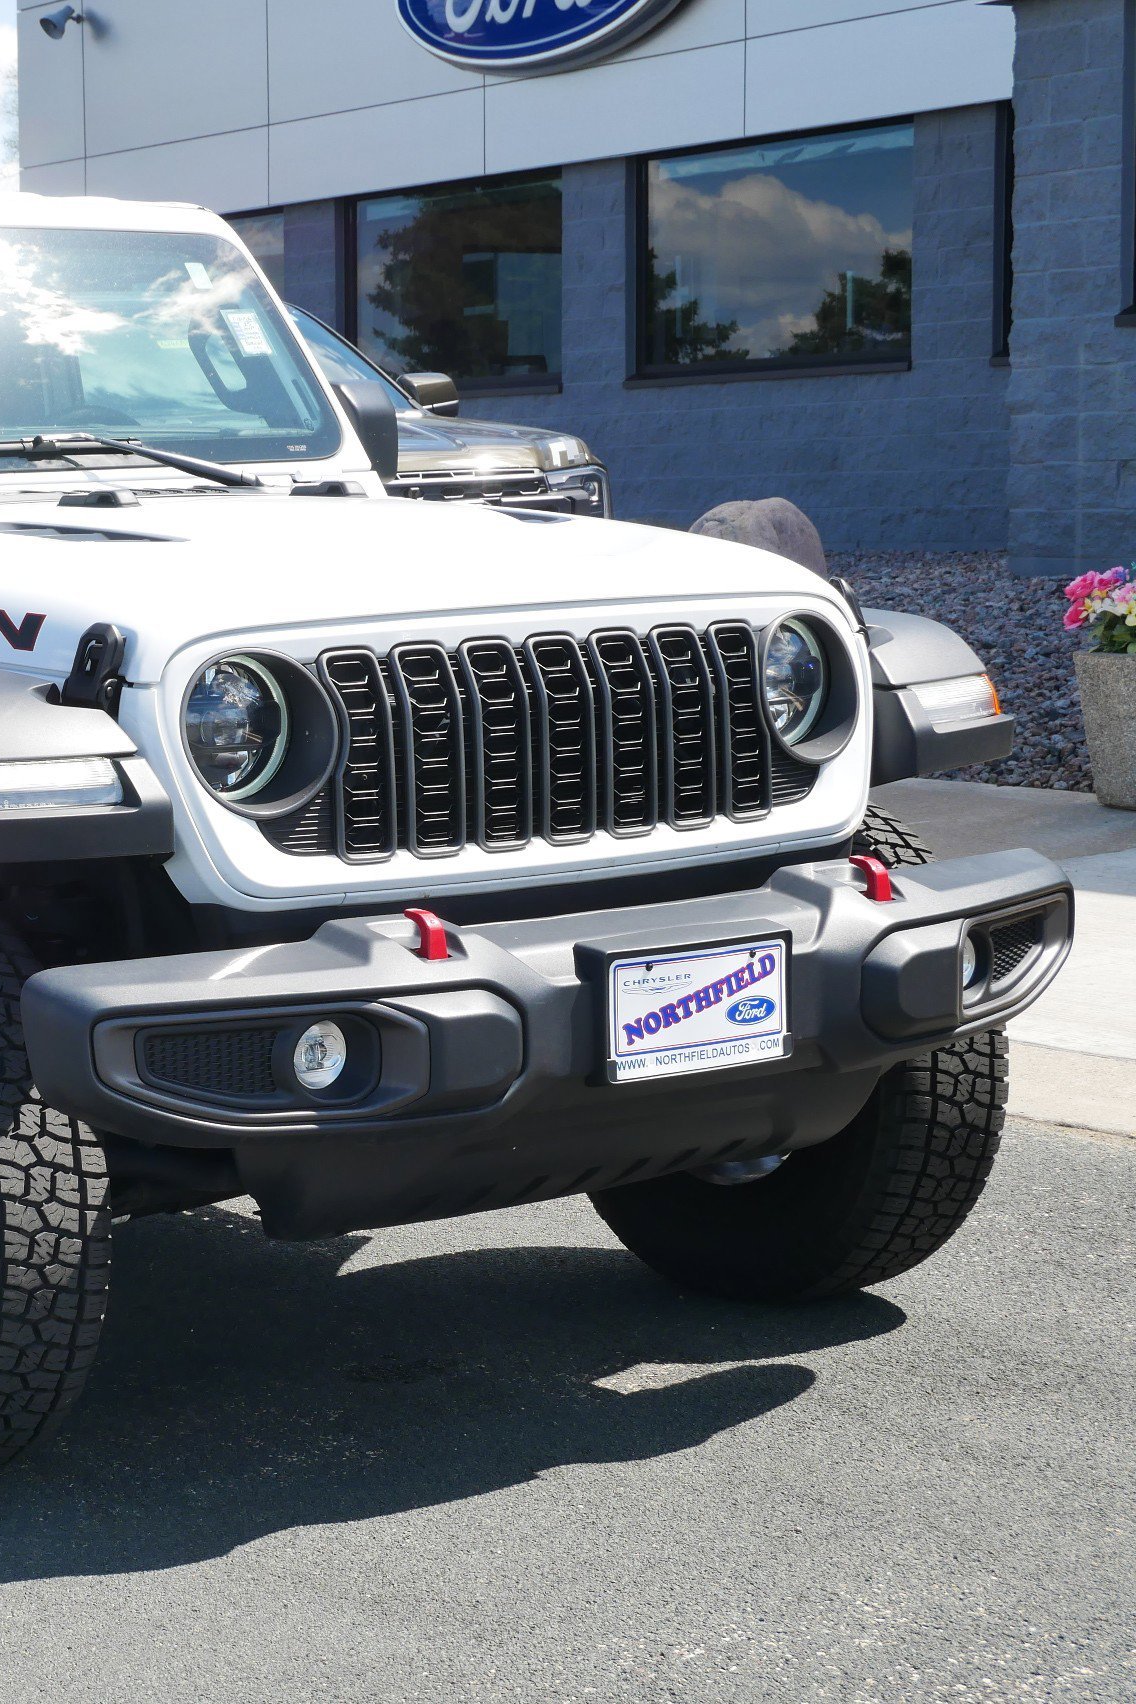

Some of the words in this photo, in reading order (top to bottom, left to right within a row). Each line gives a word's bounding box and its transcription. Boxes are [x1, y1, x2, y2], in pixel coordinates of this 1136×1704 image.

[623, 973, 691, 987] CHRYSLER
[622, 952, 776, 1046] NORTHFIELD
[735, 1000, 767, 1021] Ford
